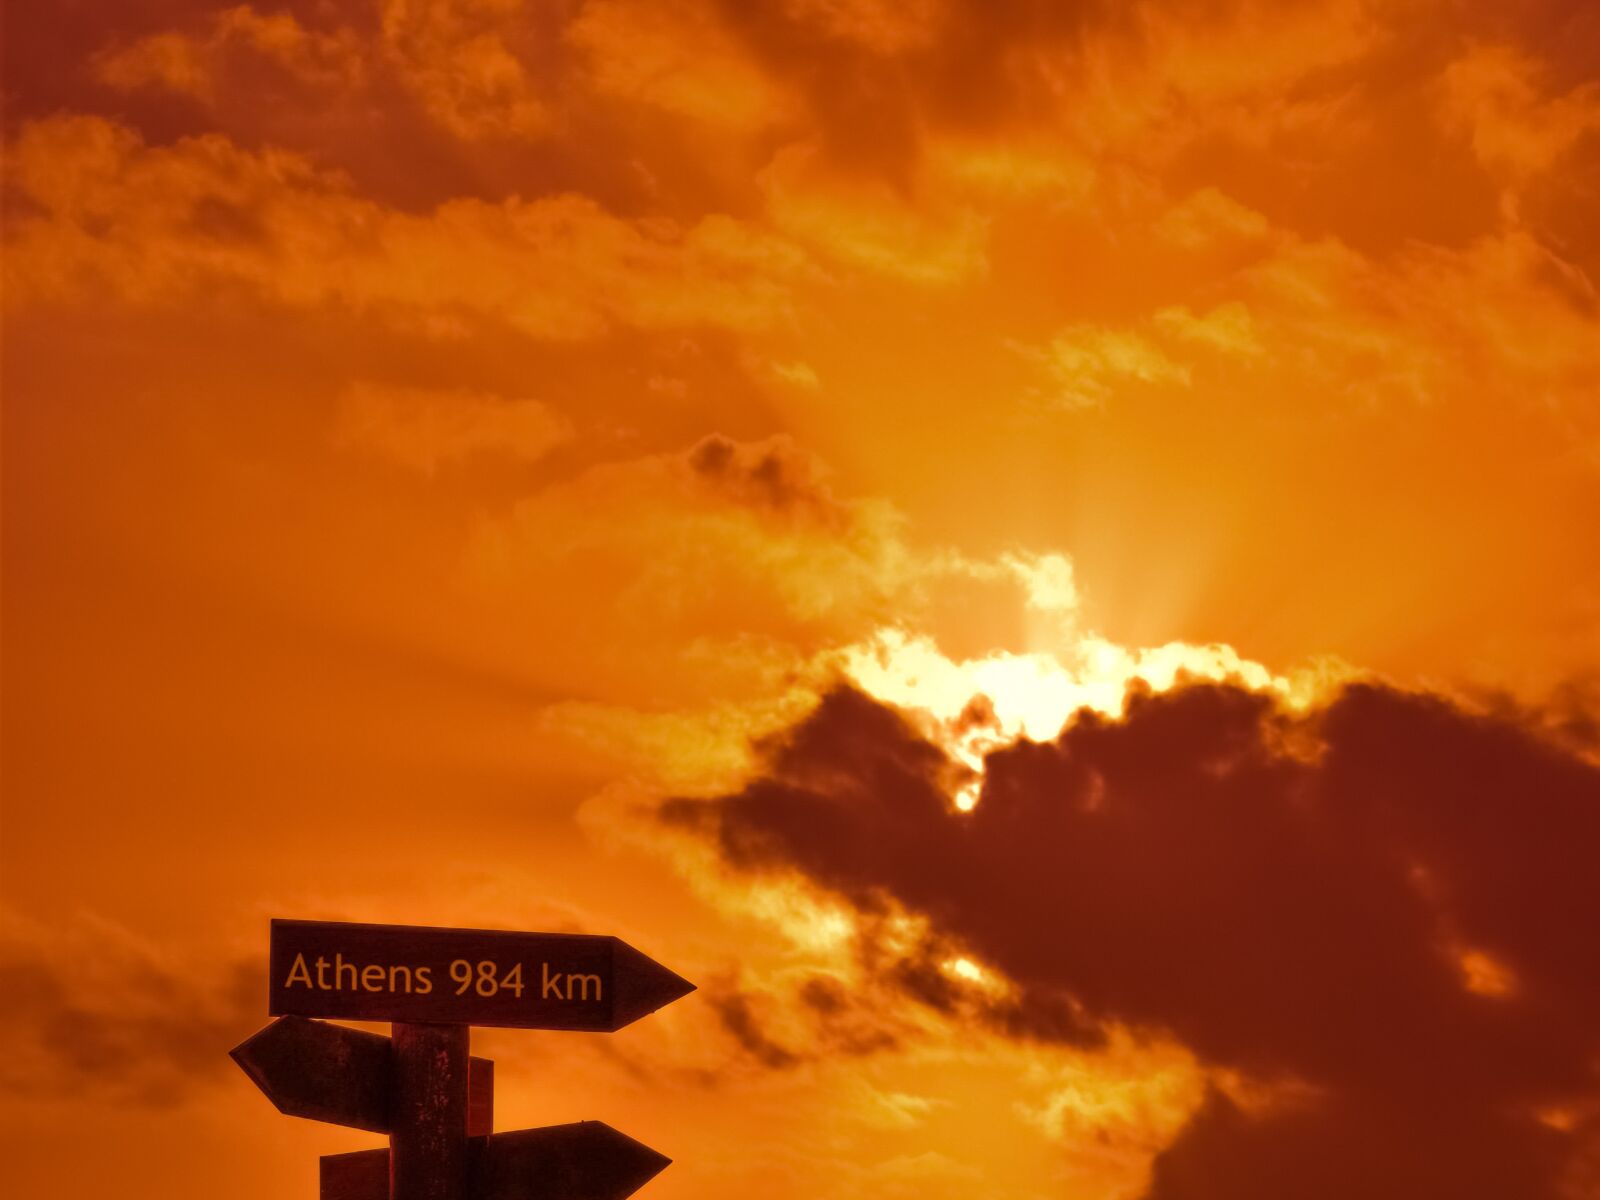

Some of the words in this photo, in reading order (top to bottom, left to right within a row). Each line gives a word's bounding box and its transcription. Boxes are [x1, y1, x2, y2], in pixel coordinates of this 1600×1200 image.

[284, 952, 433, 995] Athens
[449, 959, 525, 998] 984
[542, 962, 602, 1001] km
